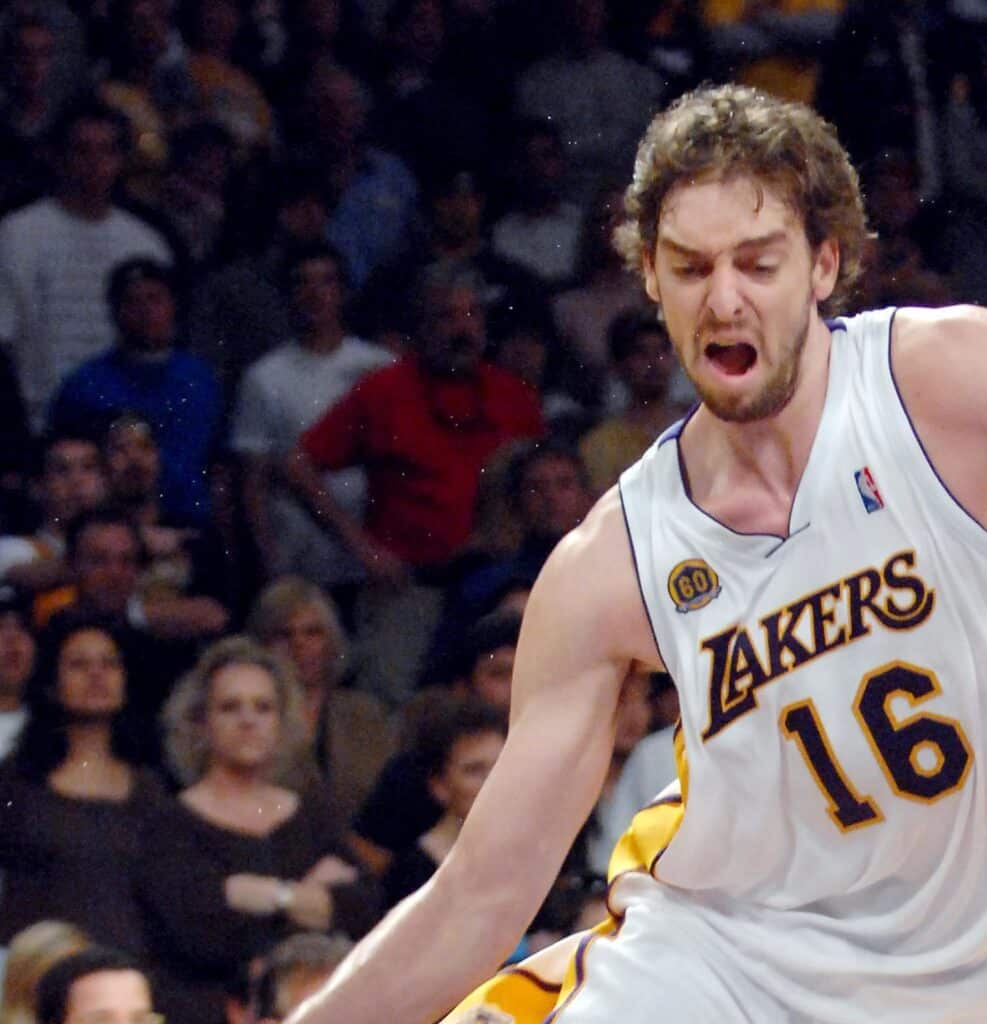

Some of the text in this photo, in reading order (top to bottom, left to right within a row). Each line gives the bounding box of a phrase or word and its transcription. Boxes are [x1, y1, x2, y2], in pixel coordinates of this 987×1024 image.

[678, 570, 709, 599] 60
[701, 548, 936, 743] LAKERS
[778, 660, 975, 833] 16
